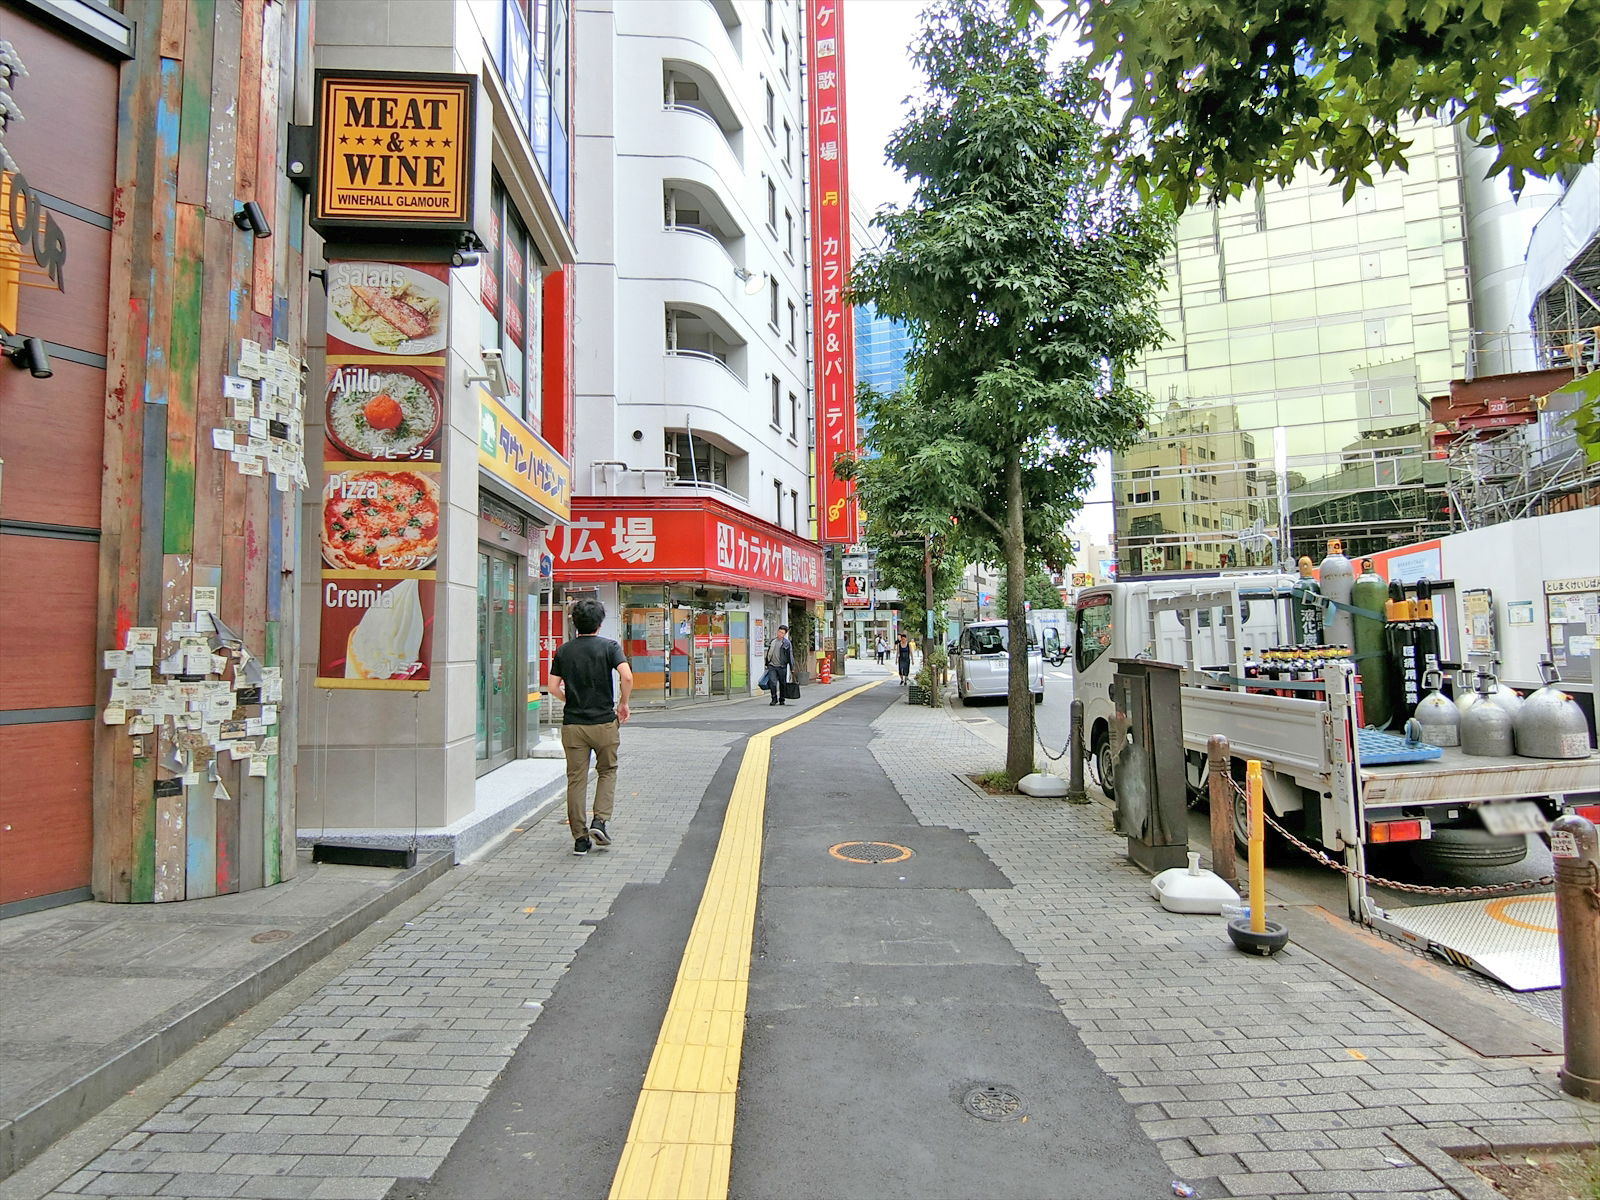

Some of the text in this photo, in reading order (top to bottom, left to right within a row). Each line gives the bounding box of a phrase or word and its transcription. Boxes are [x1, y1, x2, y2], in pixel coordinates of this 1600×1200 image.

[343, 96, 448, 131] MEAT
[817, 70, 838, 162] 歌広場
[386, 131, 405, 153] &
[342, 153, 446, 188] WINE
[337, 193, 450, 208] WINEHALL GLAMOUR
[337, 264, 405, 288] Salads
[401, 340, 440, 353] サラダ
[331, 368, 382, 398] Ajillo
[371, 446, 434, 460] アヒージョ
[328, 474, 379, 499] Pizza
[378, 553, 429, 568] ピッツァ
[737, 531, 817, 588] カラオケ 歌広場
[325, 582, 395, 608] Cremia
[374, 661, 423, 676] クレミア
